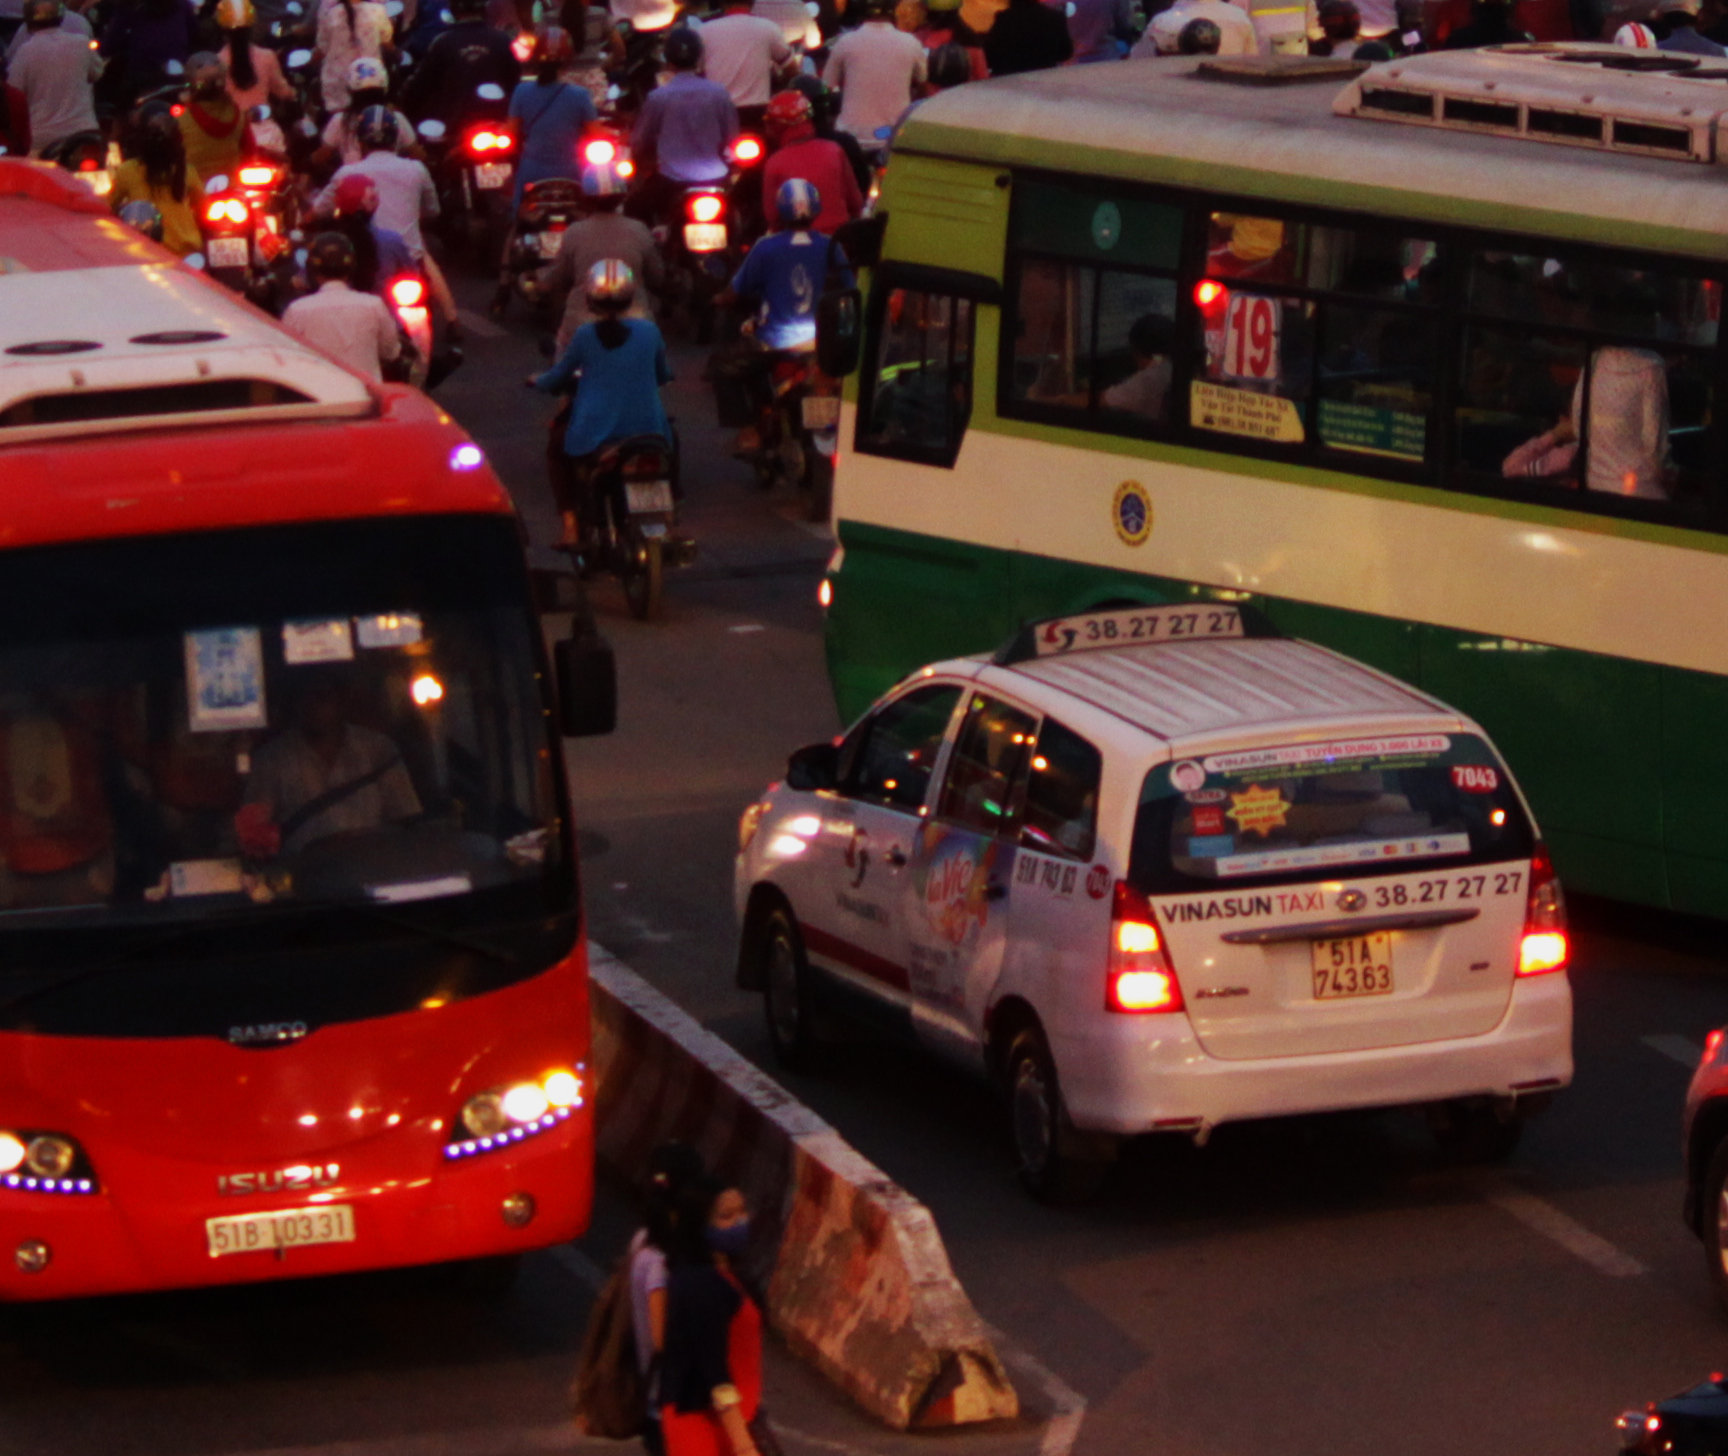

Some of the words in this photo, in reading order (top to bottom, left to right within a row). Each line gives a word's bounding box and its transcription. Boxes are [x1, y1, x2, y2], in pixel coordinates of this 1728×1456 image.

[1232, 296, 1272, 378] 19
[1086, 615, 1160, 641] 38.27
[1168, 613, 1199, 636] 27
[1207, 611, 1239, 634] 27
[1452, 765, 1497, 790] 7043
[1375, 879, 1448, 907] 38.27
[1456, 875, 1487, 898] 27
[1493, 871, 1523, 895] 27
[1161, 894, 1273, 924] VINASUN
[1276, 890, 1325, 914] TAXI
[1330, 933, 1373, 967] 51A
[1316, 964, 1391, 995] 743.63
[217, 1163, 342, 1196] ISUZU
[211, 1214, 349, 1251] 51B-103.31
